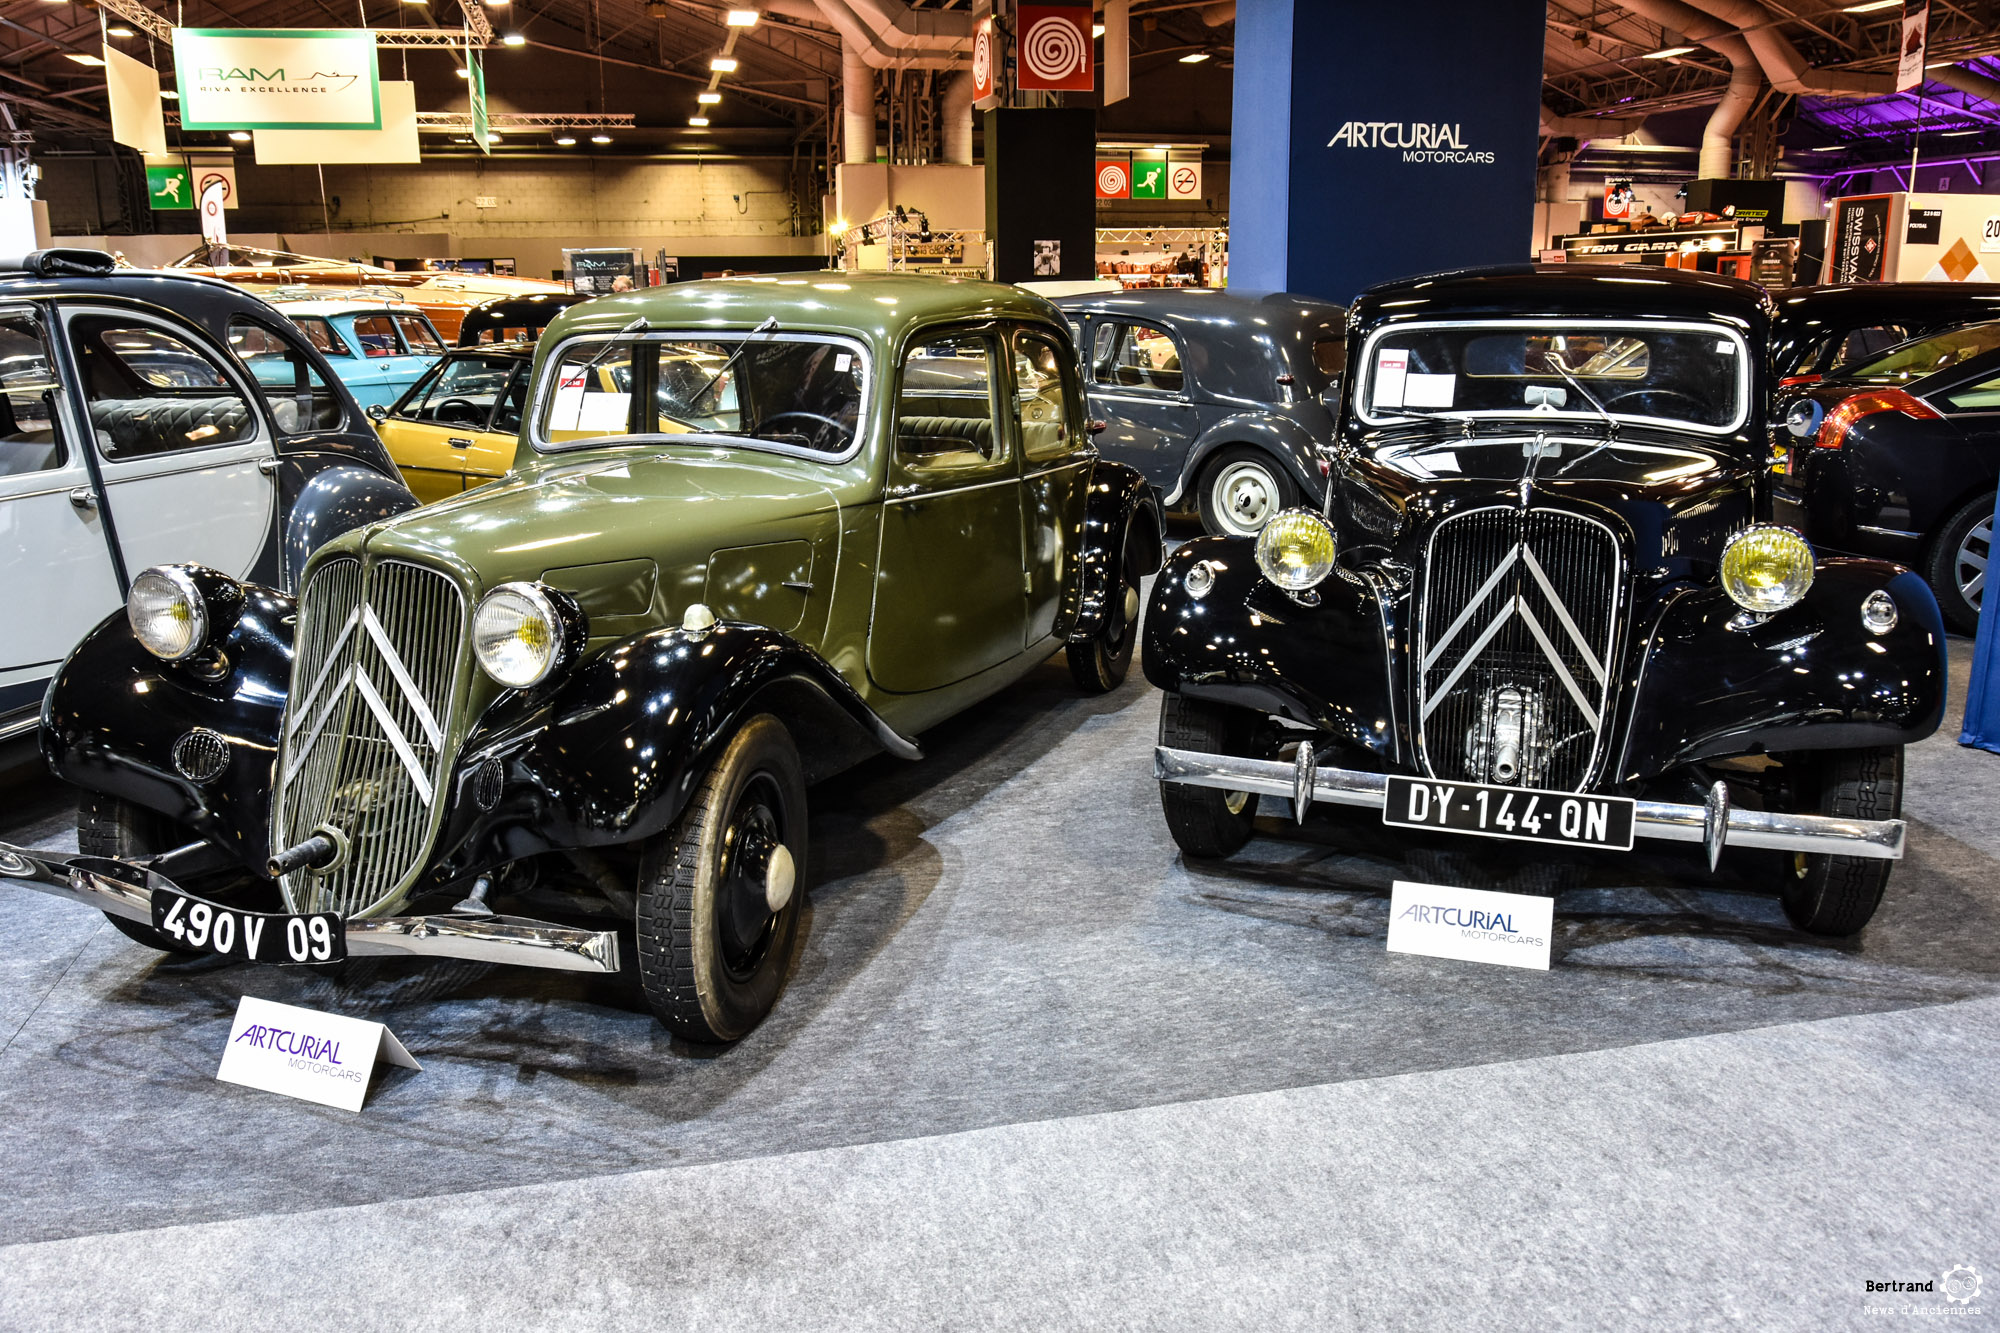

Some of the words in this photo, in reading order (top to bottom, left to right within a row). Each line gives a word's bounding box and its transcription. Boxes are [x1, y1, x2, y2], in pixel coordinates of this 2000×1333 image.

[199, 68, 285, 81] RAM
[1403, 151, 1495, 164] MOTORCARS
[1580, 244, 1618, 253] TRM
[1847, 206, 1864, 283] SWISSVAX
[1408, 783, 1608, 841] DY-144-QN
[163, 897, 235, 954] 490
[244, 916, 265, 960] V
[287, 916, 331, 962] 09
[1461, 929, 1544, 947] MOTORCARS
[288, 1057, 362, 1082] MOTORCARS
